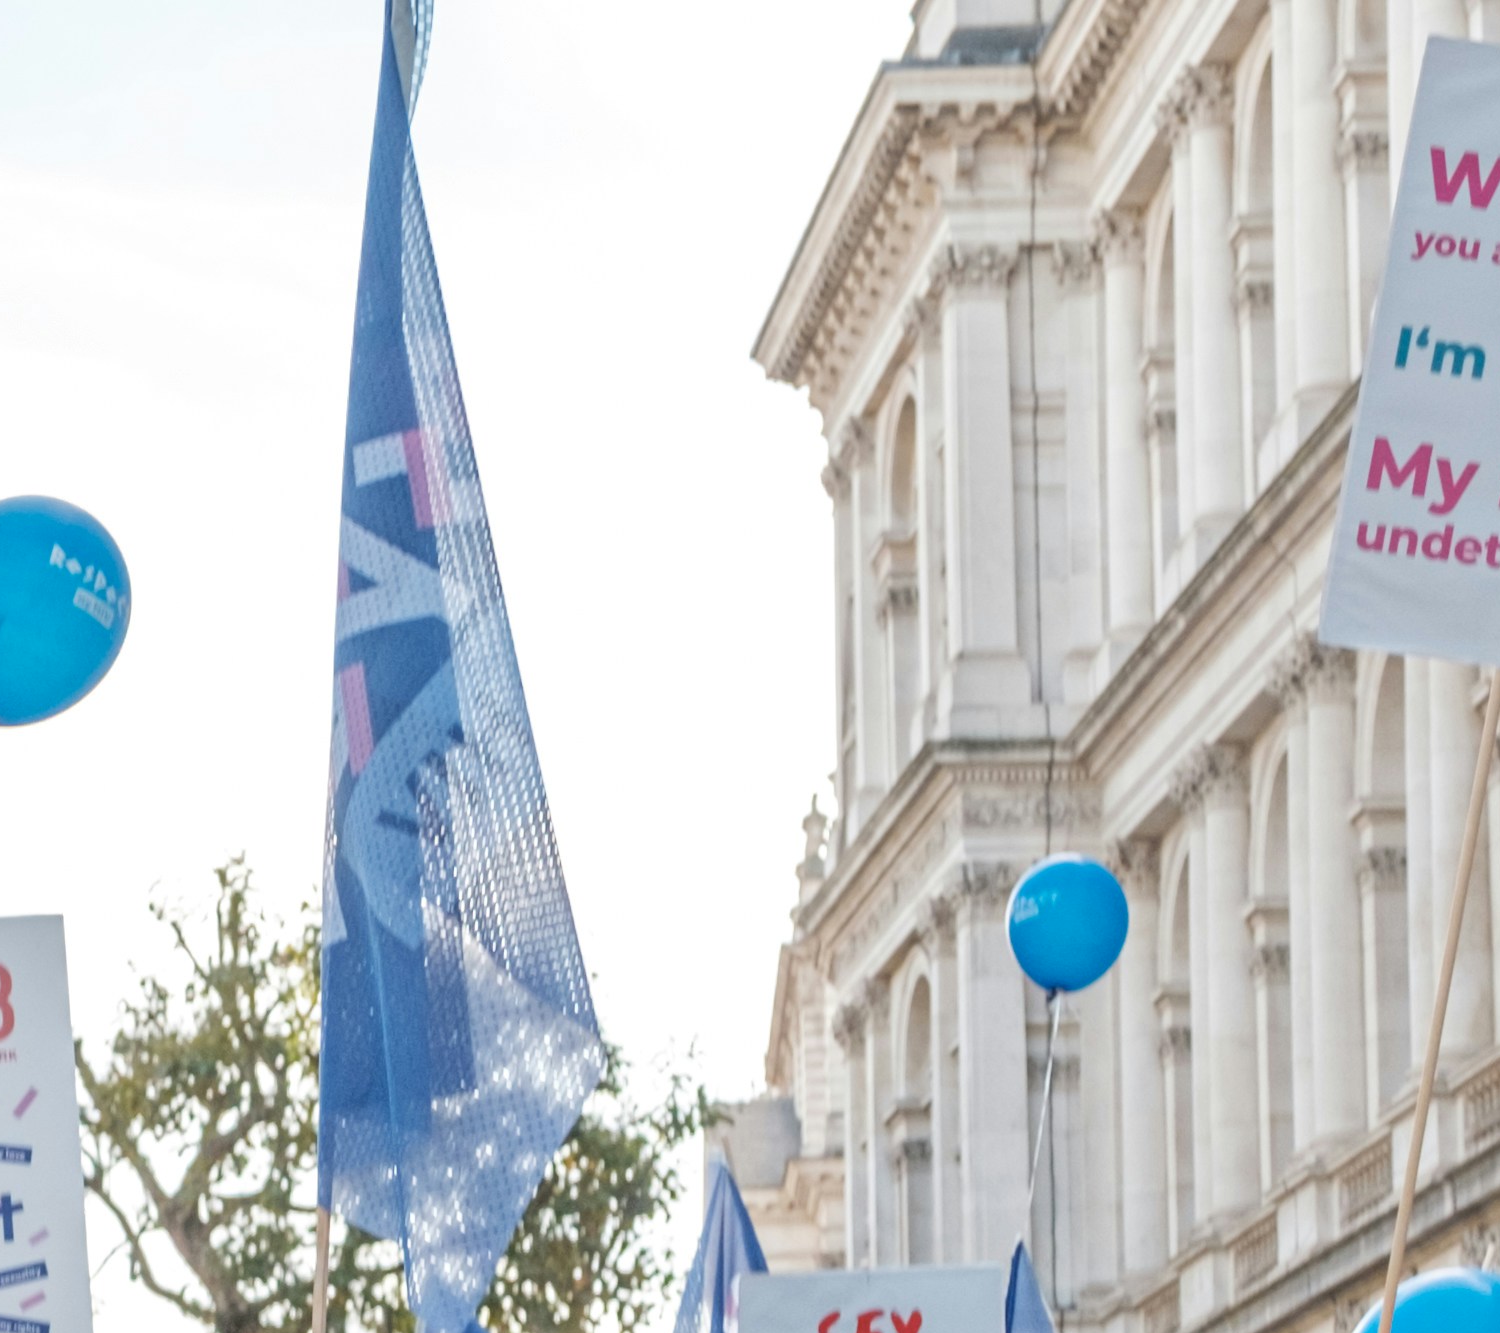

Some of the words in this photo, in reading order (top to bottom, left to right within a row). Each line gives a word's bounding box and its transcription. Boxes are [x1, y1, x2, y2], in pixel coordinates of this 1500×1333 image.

[1410, 229, 1481, 261] you
[1393, 325, 1487, 381] I'm
[1365, 437, 1480, 515] My
